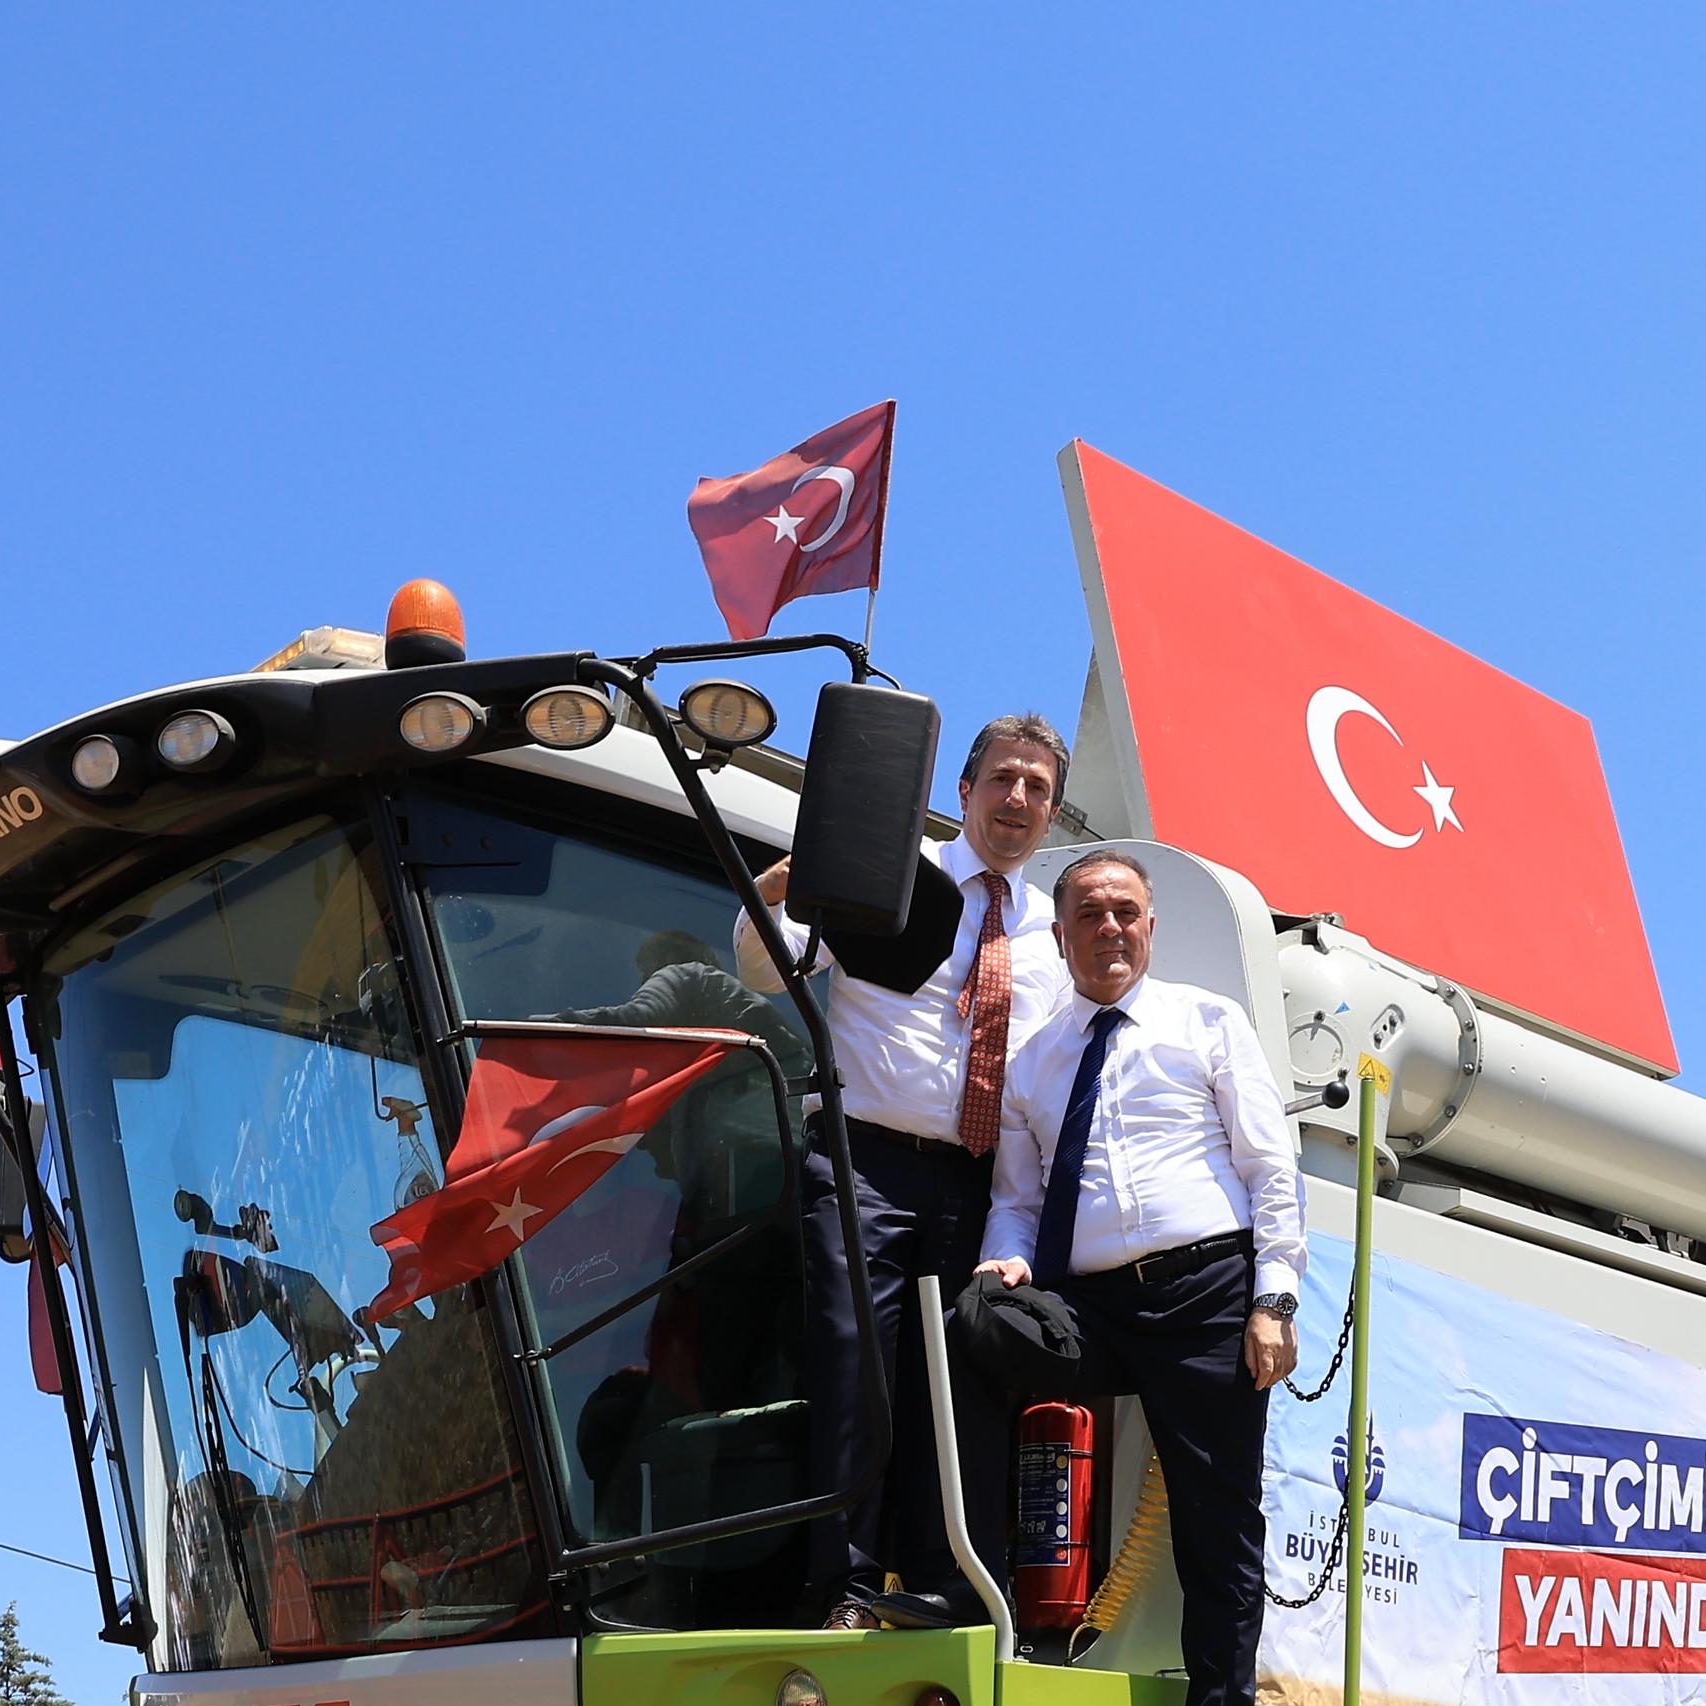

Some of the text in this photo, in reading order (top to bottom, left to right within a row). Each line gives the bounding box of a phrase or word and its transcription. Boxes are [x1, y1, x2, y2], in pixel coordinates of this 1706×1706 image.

[1309, 1510, 1400, 1548] İSTBUL
[1285, 1532, 1419, 1585] BÜYŞEHİR
[1308, 1572, 1397, 1604] BELEYESİ
